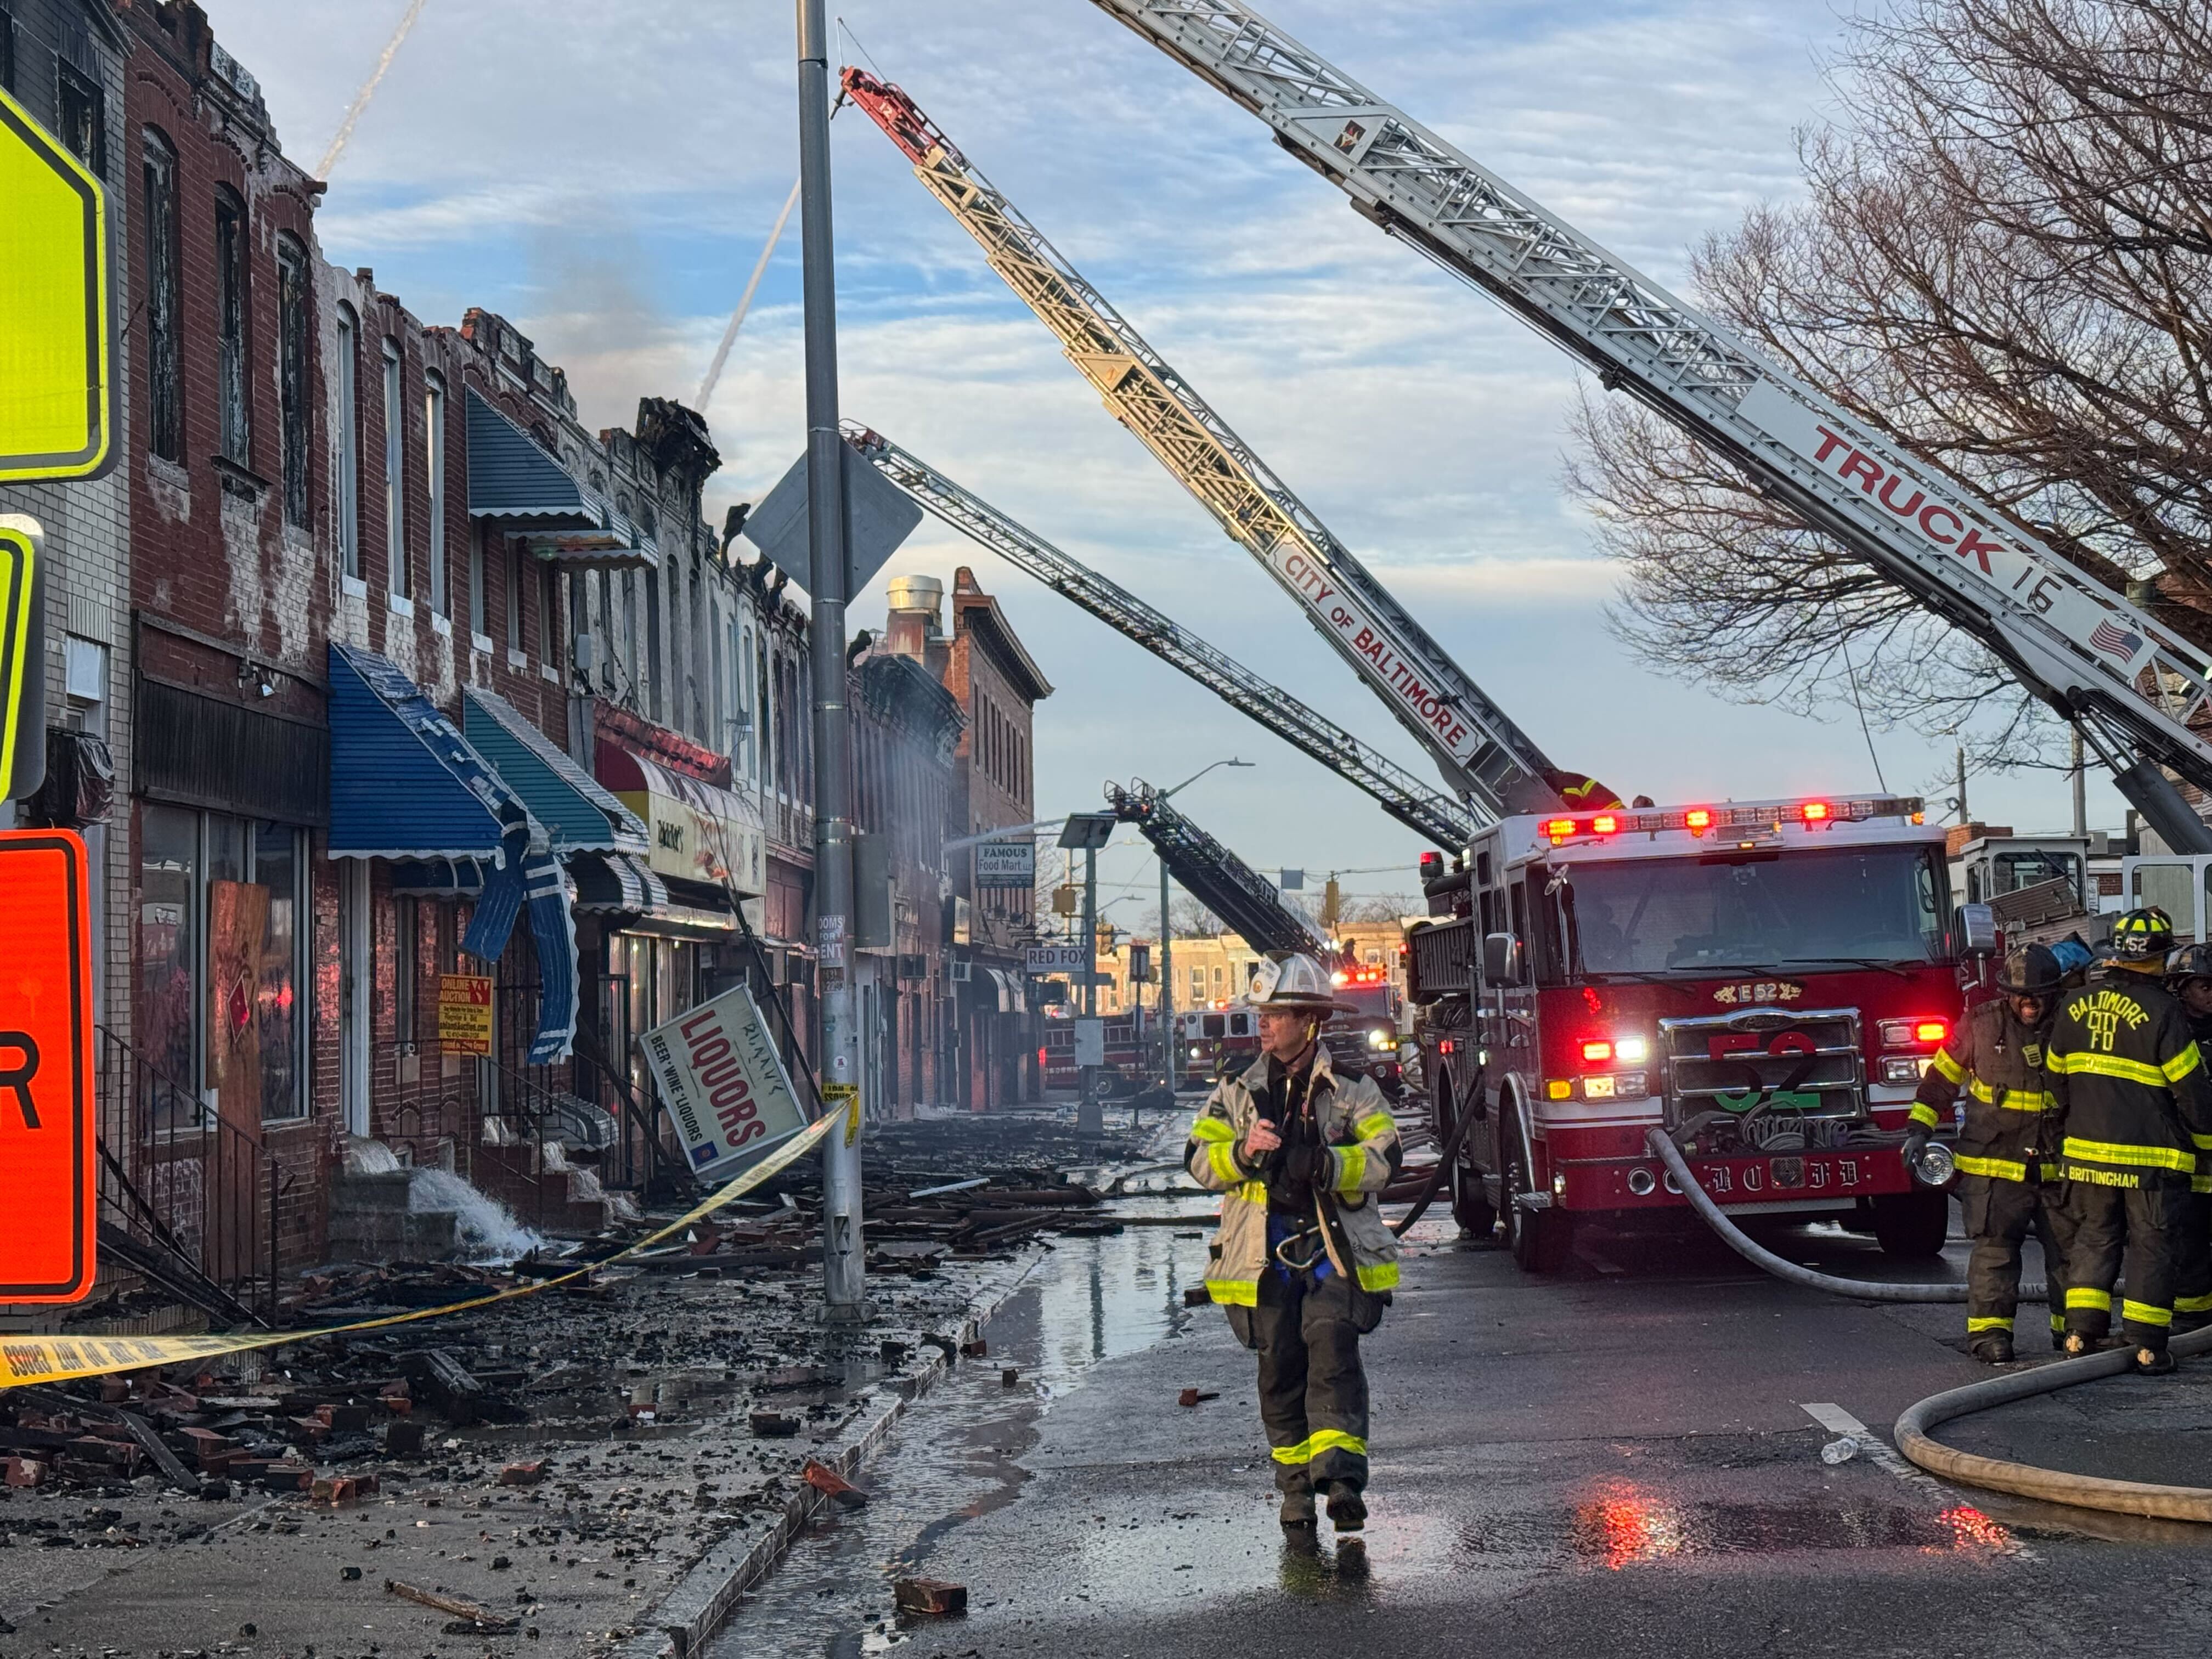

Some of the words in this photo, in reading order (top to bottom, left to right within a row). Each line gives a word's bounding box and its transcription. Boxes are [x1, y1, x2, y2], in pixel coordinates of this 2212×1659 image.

[1814, 425, 2010, 577] TRUCK
[1285, 555, 1335, 604] CITY
[1331, 606, 1355, 629] OF
[1352, 625, 1467, 748] BALTIMORE
[983, 848, 1027, 857] FAMOUS
[979, 859, 998, 871] Food
[1001, 859, 1021, 871] Mart
[1029, 950, 1055, 964] RED
[1060, 950, 1086, 964] FOX
[441, 978, 470, 990] ONLINE
[1738, 984, 1752, 1002] E
[1754, 983, 1777, 1002] 52
[439, 990, 471, 1003] AUCTION
[2068, 990, 2150, 1031] BALTIMORE
[2087, 1010, 2119, 1033] CITY
[2091, 1029, 2113, 1052] FD
[680, 1009, 766, 1147] LIQUORS
[1708, 1031, 1821, 1113] 52
[651, 1035, 669, 1064] BEER
[663, 1065, 683, 1095] WINE
[675, 1097, 703, 1142] LIQUORS
[2058, 1163, 2066, 1178] J.
[2069, 1165, 2139, 1189] BRITTINGHAM
[3, 1344, 53, 1377] CROSS
